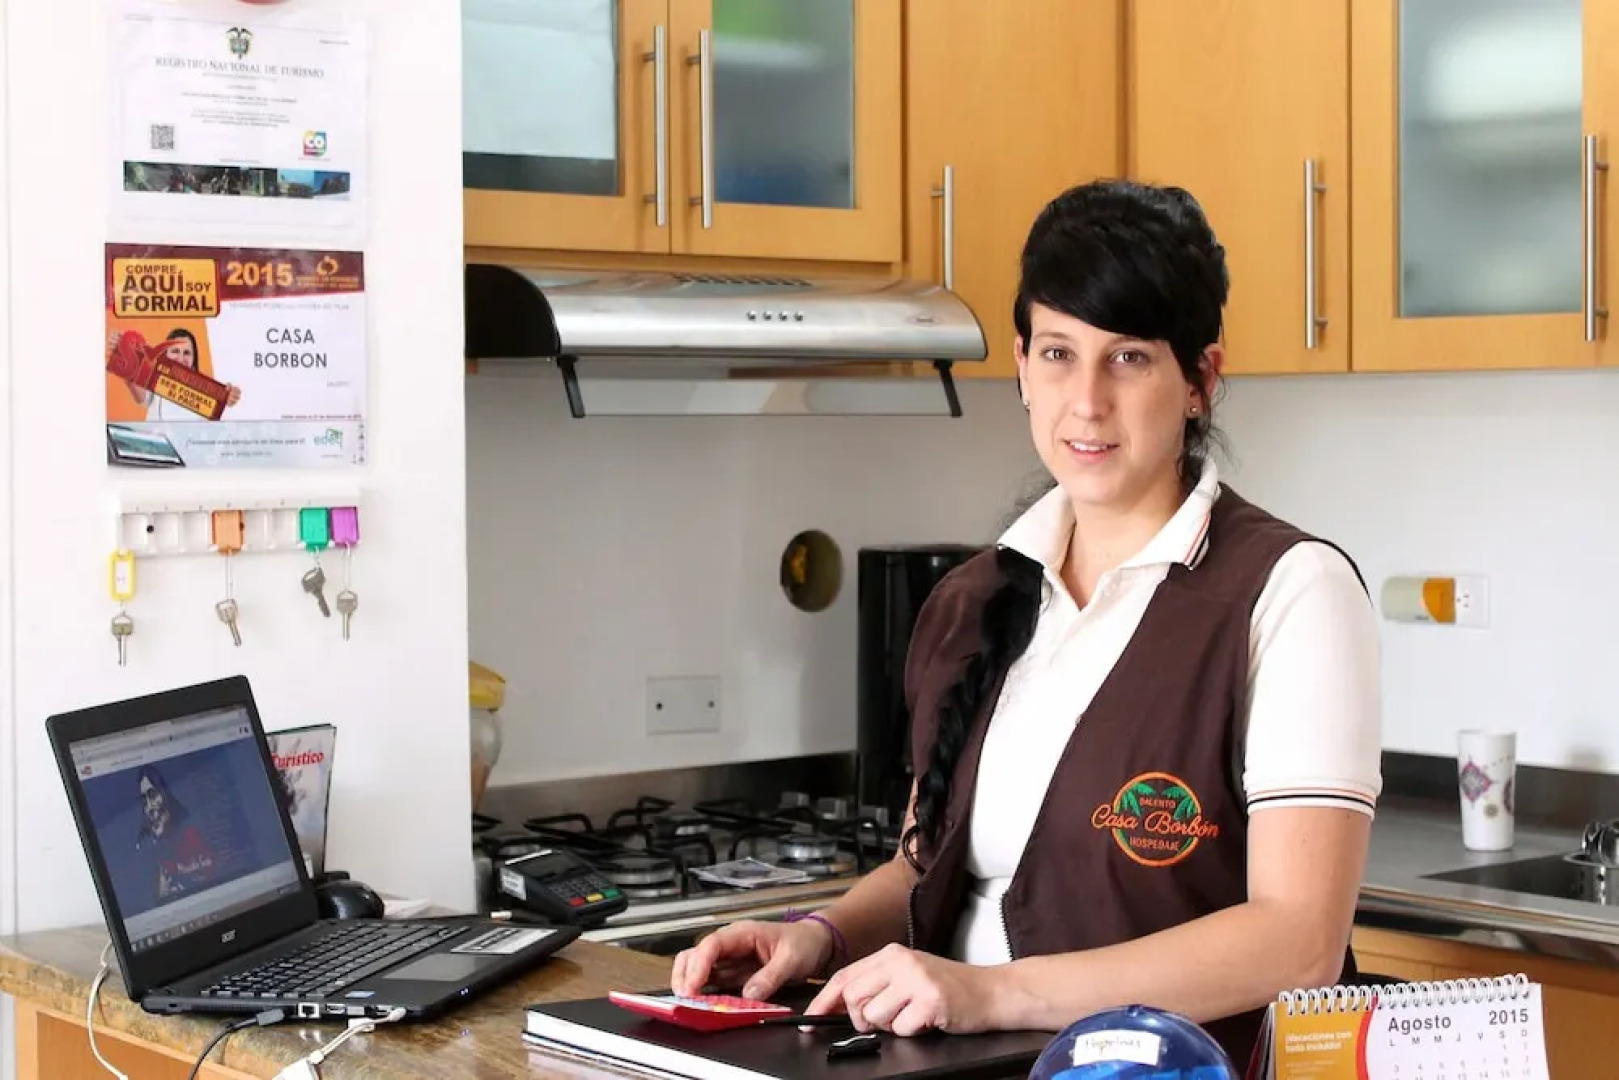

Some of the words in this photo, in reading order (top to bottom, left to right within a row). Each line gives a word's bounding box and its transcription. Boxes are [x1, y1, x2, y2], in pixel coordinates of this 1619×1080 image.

[154, 56, 208, 70] REGISTRO
[209, 60, 261, 73] NACIONAL
[264, 64, 279, 75] DE
[281, 66, 325, 79] TURISMO
[125, 264, 177, 275] COMPRE
[226, 260, 294, 287] 2015
[122, 269, 184, 294] AQUÍ
[185, 281, 212, 293] SOY
[120, 295, 213, 312] FORMAL
[265, 328, 315, 345] CASA
[253, 352, 328, 369] BORBON
[1090, 803, 1139, 829] Casa
[1129, 836, 1181, 851] HOSPEDAJE
[1387, 1013, 1452, 1036] Agosto
[1488, 1008, 1530, 1027] 2015
[1411, 1036, 1421, 1045] M
[1433, 1035, 1443, 1044] M
[1456, 1032, 1462, 1042] J
[1477, 1032, 1484, 1041] V
[1498, 1029, 1506, 1039] S
[1521, 1028, 1528, 1038] D
